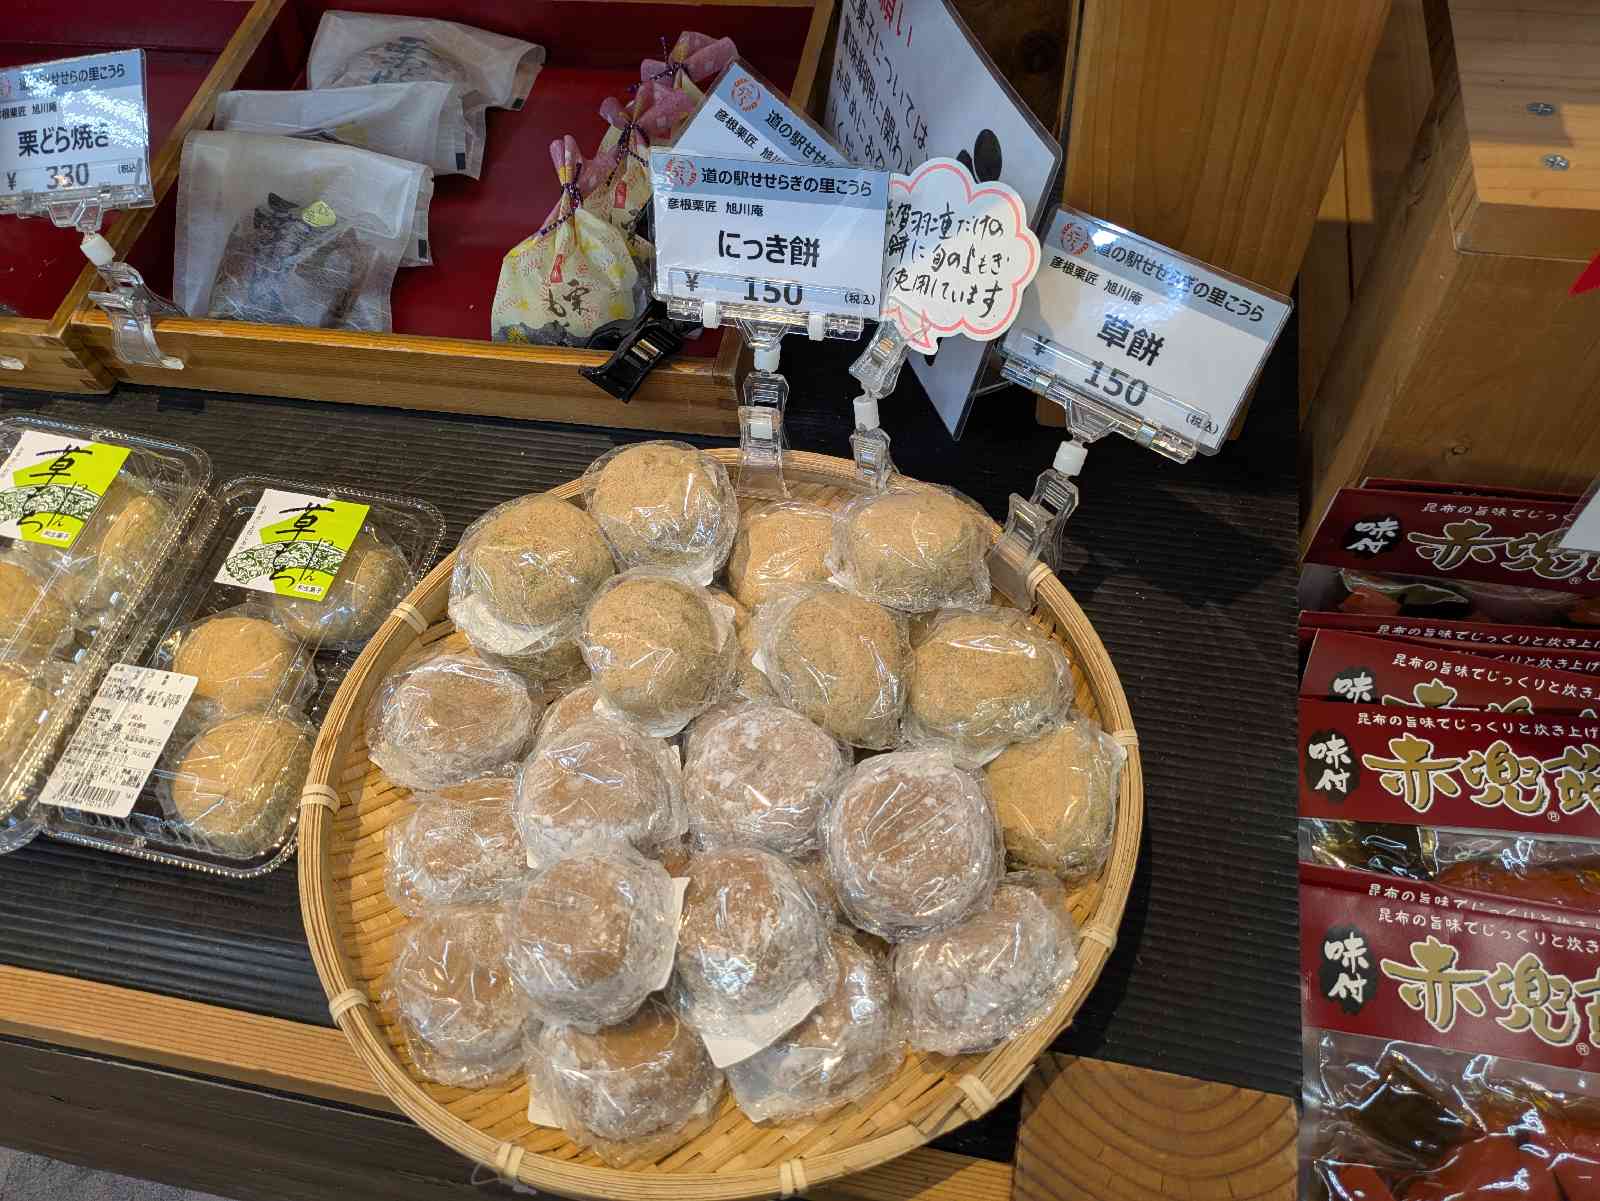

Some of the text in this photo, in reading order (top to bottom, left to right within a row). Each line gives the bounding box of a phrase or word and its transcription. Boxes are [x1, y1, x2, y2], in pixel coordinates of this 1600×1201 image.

[17, 122, 110, 158] 栗どら焼き
[45, 161, 90, 190] 330
[701, 166, 873, 197] 道の駅せせらぎの里こうら
[667, 197, 764, 217] 彦根栗匠 旭川庵
[718, 229, 821, 269] にっき餅
[685, 270, 876, 306] ¥ 150 (税込)
[886, 266, 1003, 318] 使用しています
[1049, 255, 1144, 306] 彦根栗匠 旭川庵
[1097, 313, 1166, 367] 草餅
[1032, 335, 1220, 435] ¥ 150 (税込)
[1346, 517, 1400, 555] 味付
[1407, 518, 1600, 580] 赤兜
[1356, 712, 1600, 739] 昆布の旨味でじっくりと炊き上げ
[1308, 733, 1351, 793] 味付
[1379, 907, 1600, 953] 昆布の旨味でじっくりと炊き
[1324, 930, 1370, 1004] 味付
[1379, 935, 1600, 1047] 赤兜
